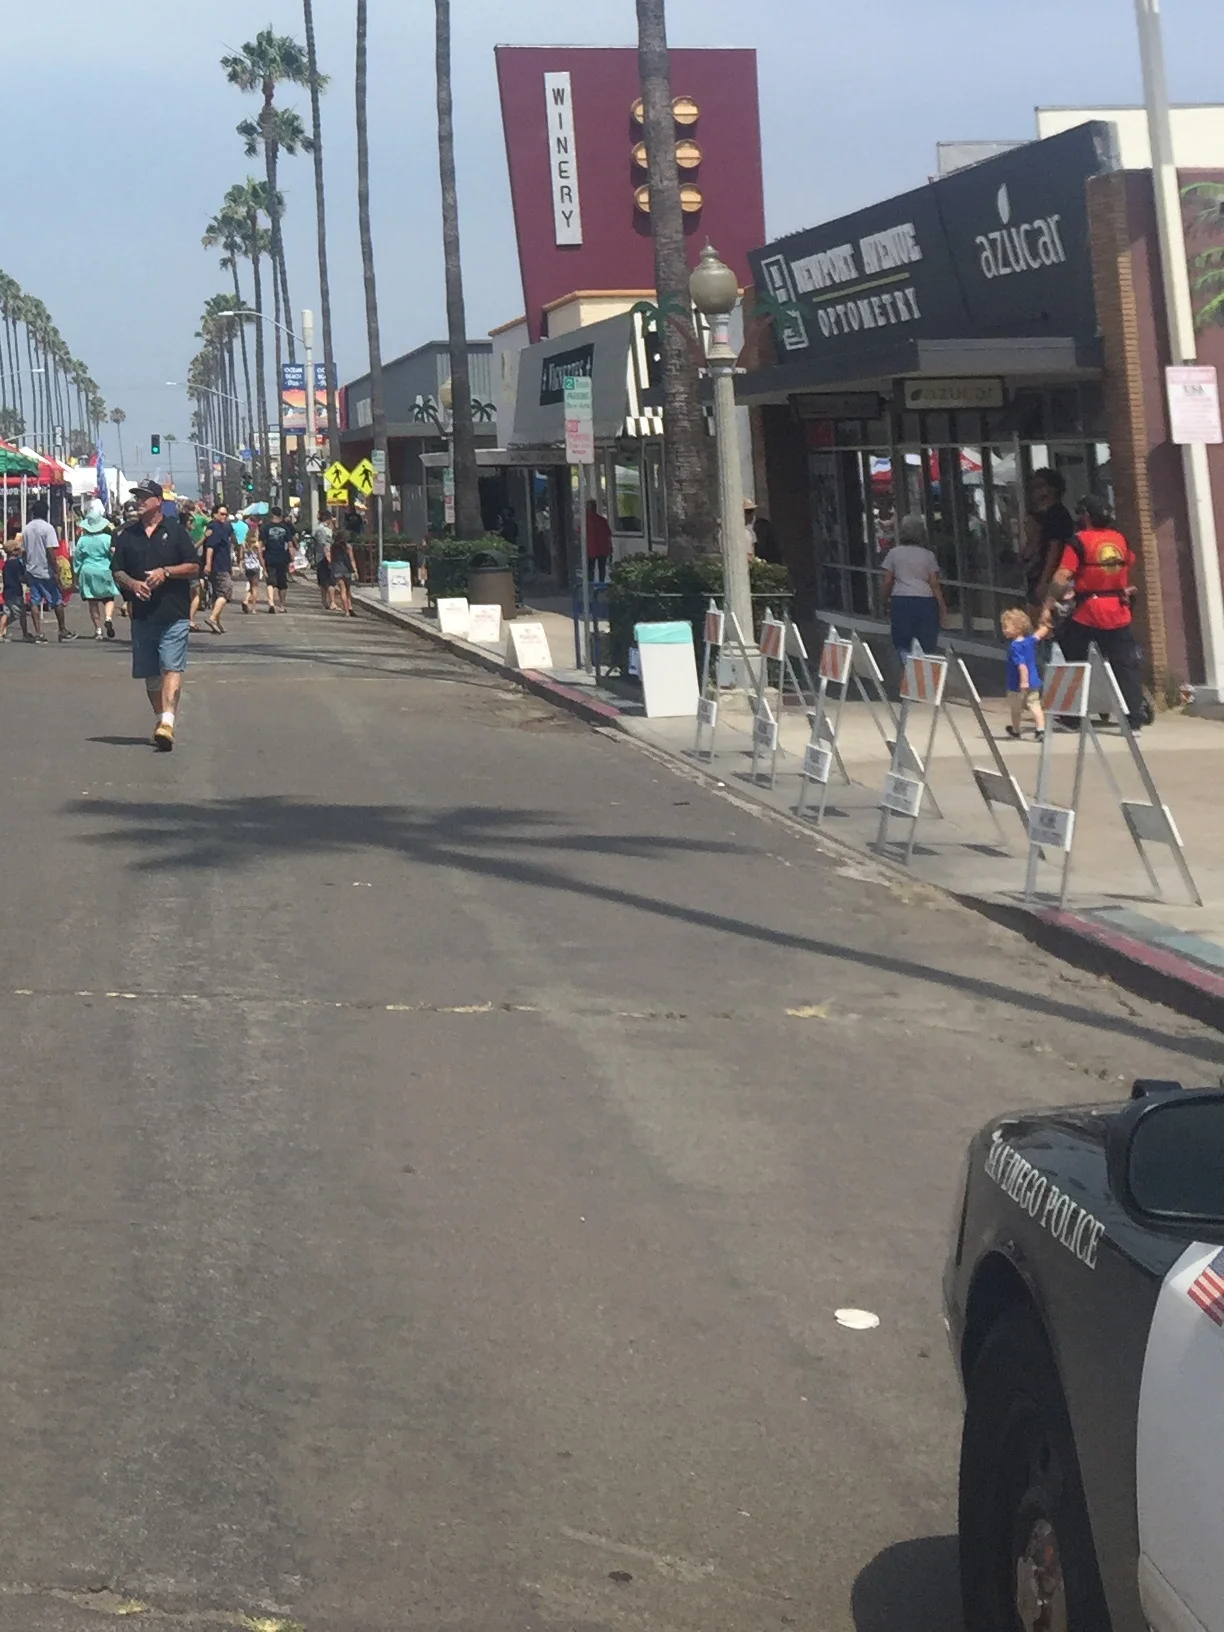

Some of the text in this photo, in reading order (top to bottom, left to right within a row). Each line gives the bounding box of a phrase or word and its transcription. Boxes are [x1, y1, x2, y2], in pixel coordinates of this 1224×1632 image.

[552, 87, 573, 228] WINERY
[790, 243, 860, 294] NEWPORT
[859, 222, 923, 275] AVENUE
[817, 287, 922, 338] OPTOMETRY
[1000, 1152, 1047, 1218] DIEGO
[1040, 1185, 1106, 1270] POLICE
